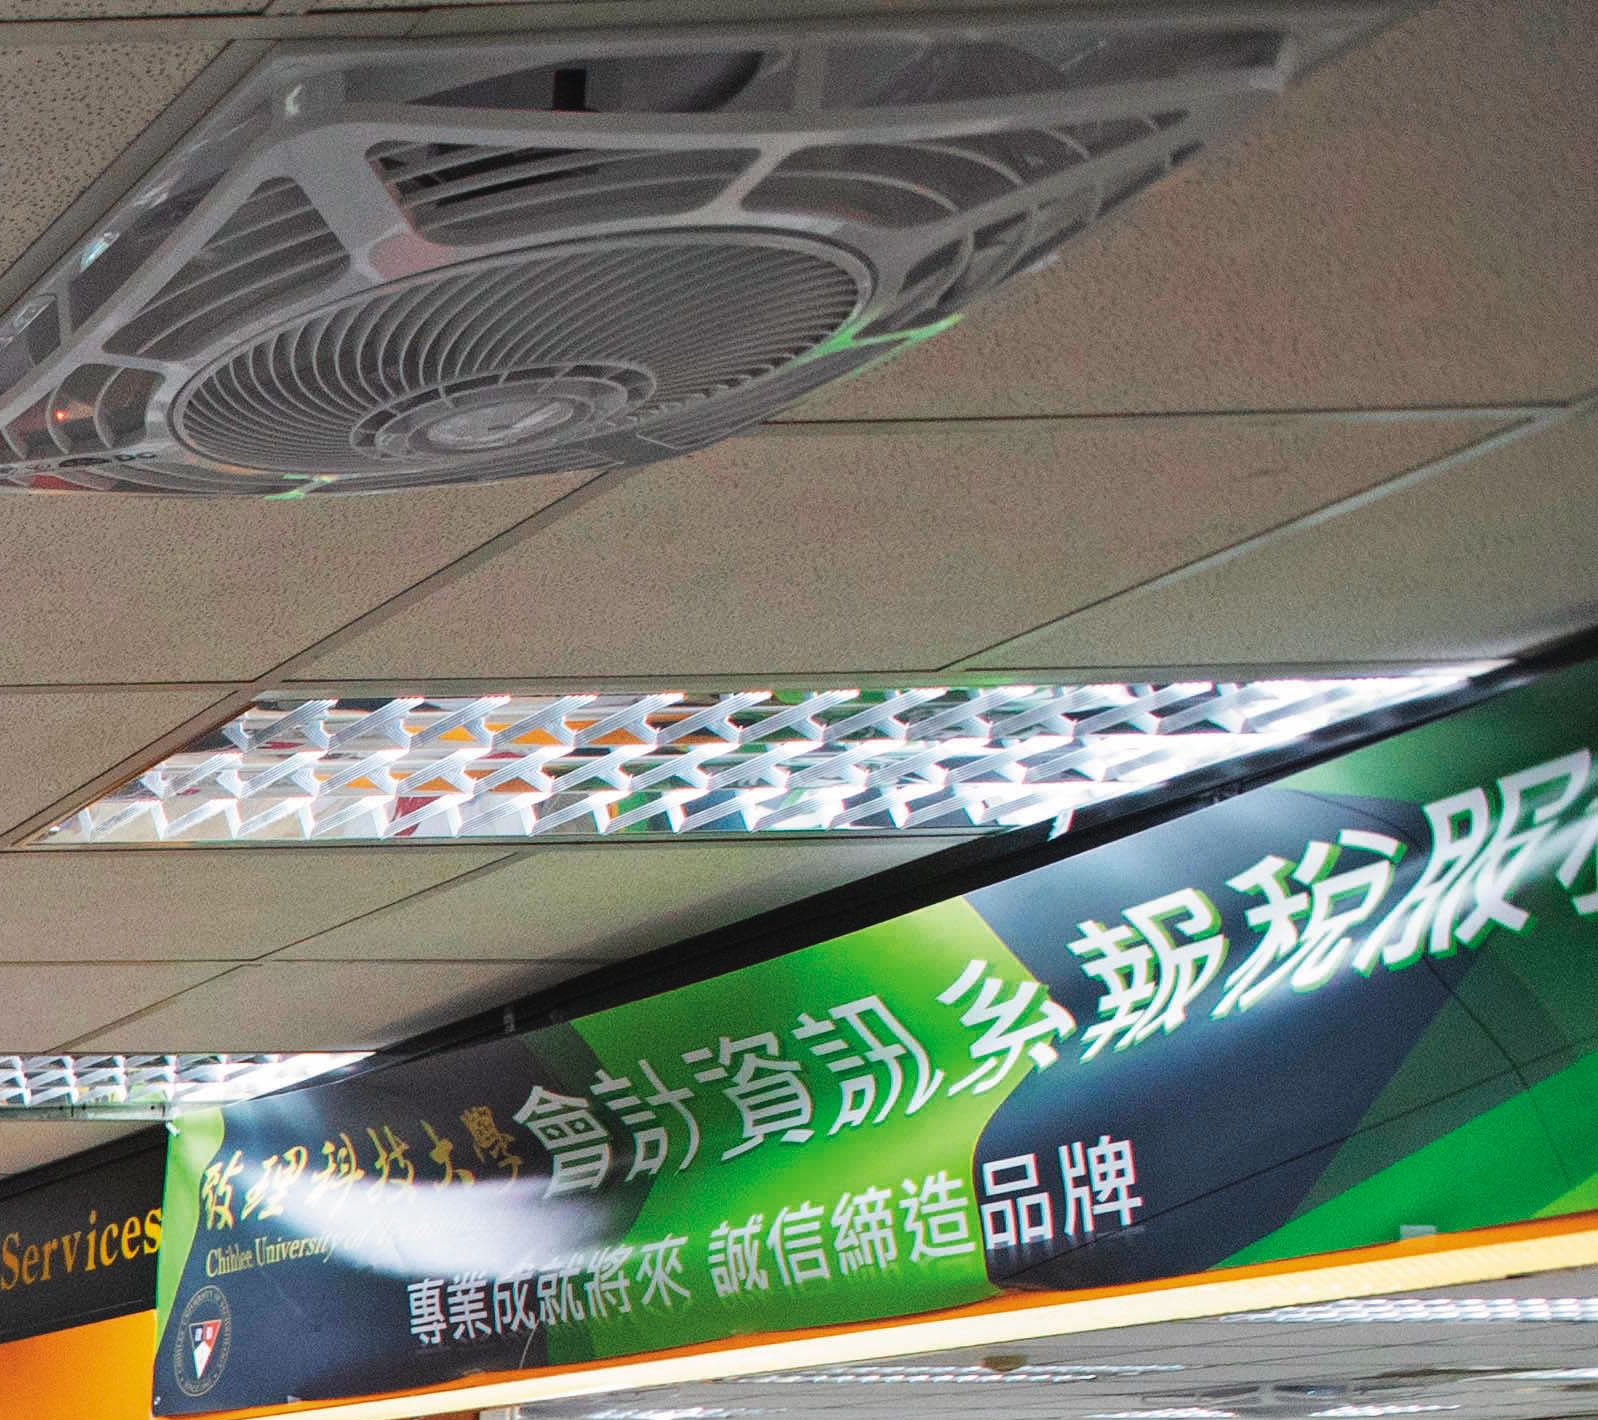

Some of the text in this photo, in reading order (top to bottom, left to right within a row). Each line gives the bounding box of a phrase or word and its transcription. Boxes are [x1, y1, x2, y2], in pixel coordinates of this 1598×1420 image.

[0, 1207, 162, 1290] Services
[206, 1248, 253, 1277] Chihlee
[407, 1134, 1143, 1345] 專業成就將來 誠信締造品牌
